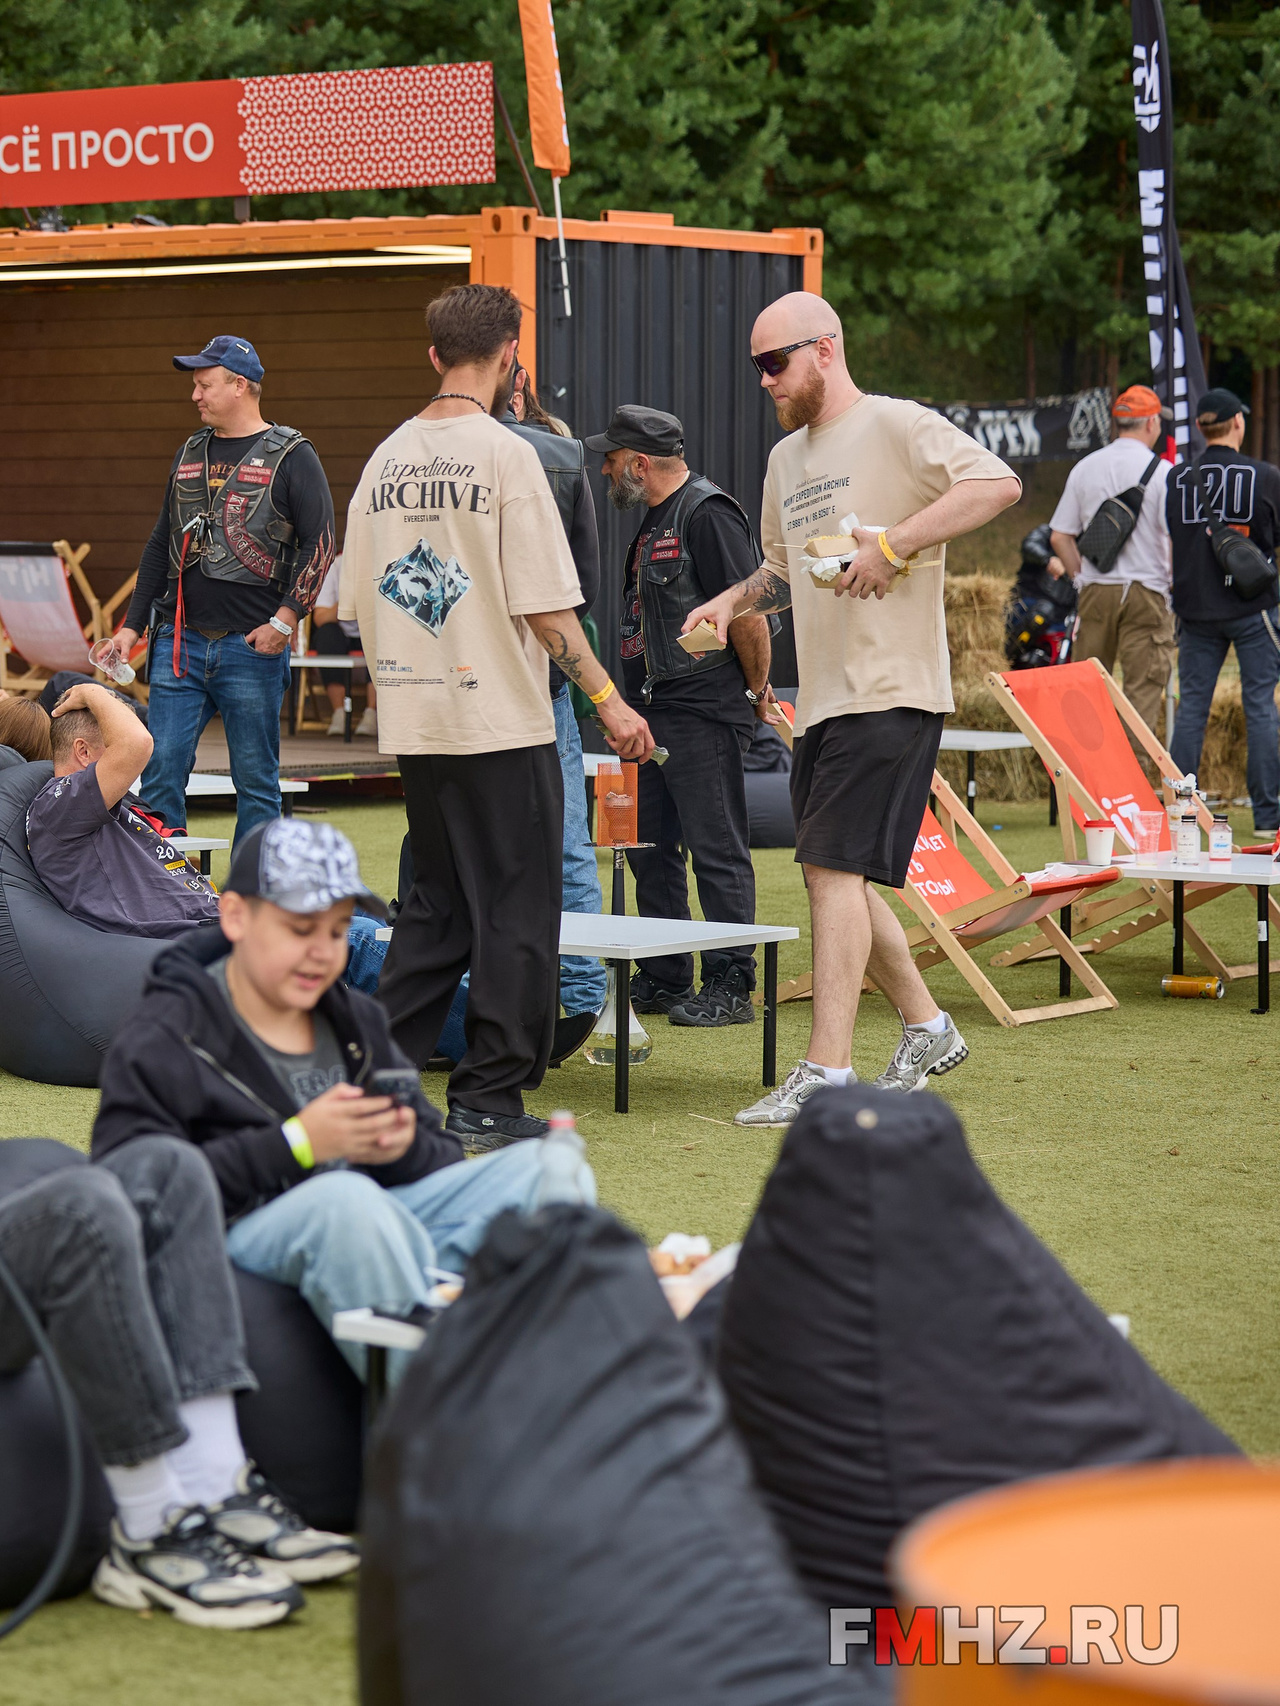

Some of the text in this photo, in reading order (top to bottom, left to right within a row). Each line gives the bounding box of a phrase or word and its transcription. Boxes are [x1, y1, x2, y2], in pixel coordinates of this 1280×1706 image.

[51, 122, 214, 171] ПРОСТО
[380, 456, 475, 483] Expedition
[366, 480, 491, 515] ARCHIVE
[795, 484, 823, 502] EXPEDITION
[823, 476, 850, 492] ARCHIVE
[1176, 464, 1256, 524] 120
[404, 515, 426, 523] EVEREST
[156, 845, 175, 860] 20
